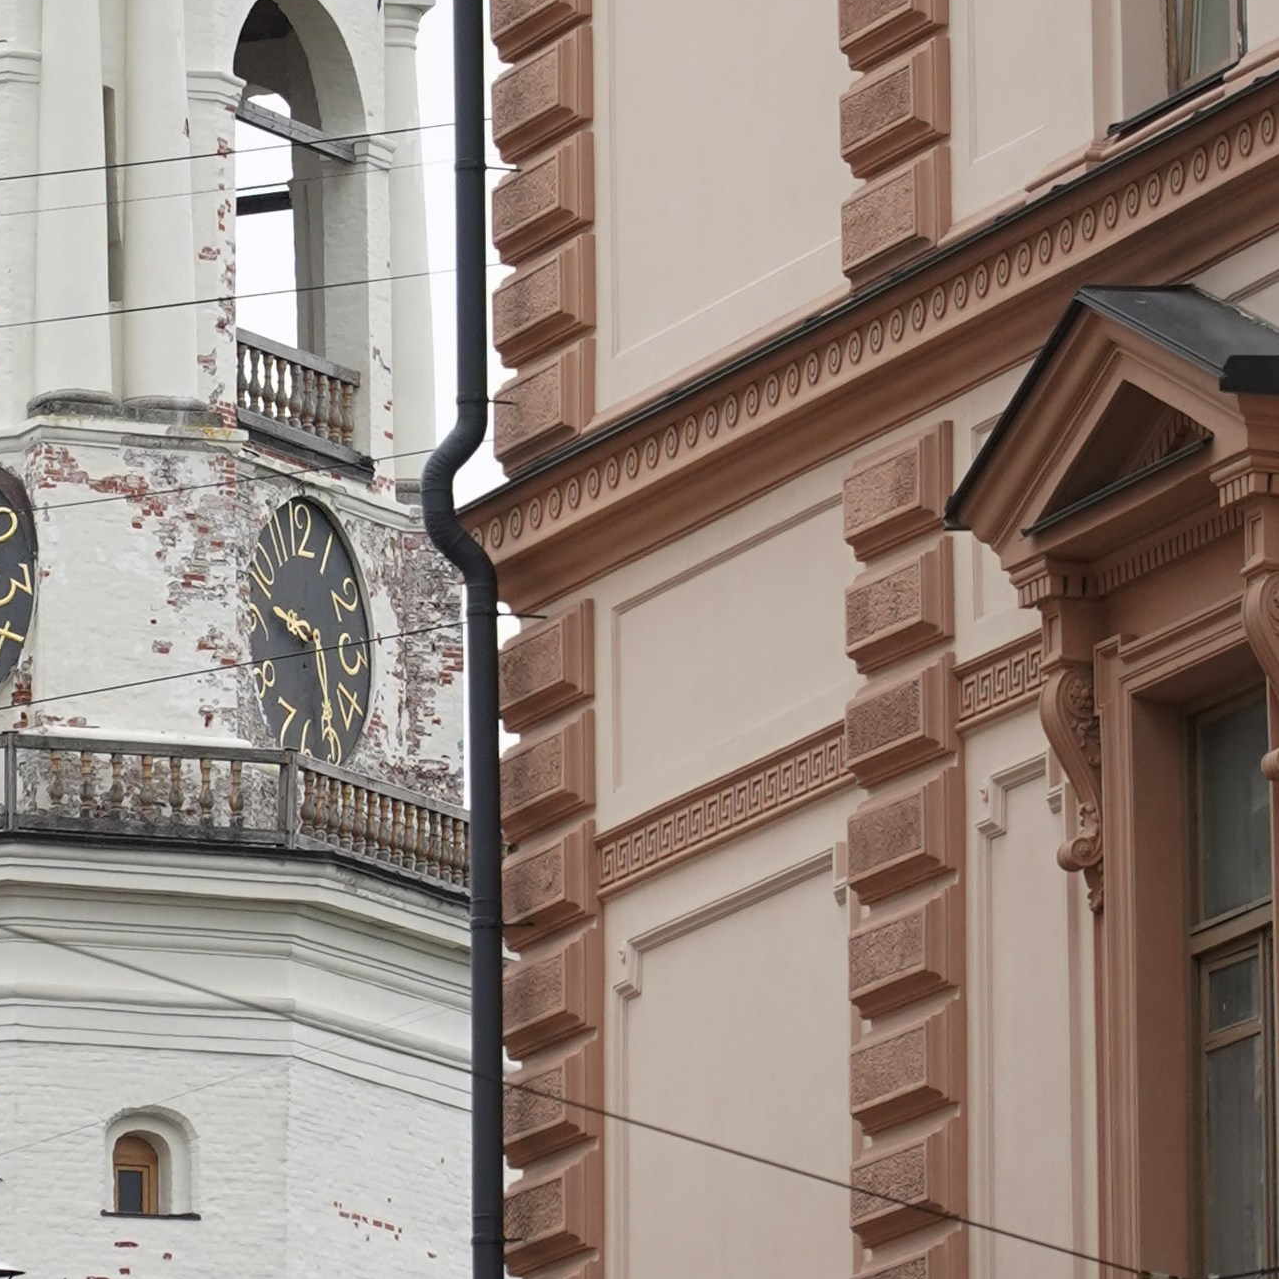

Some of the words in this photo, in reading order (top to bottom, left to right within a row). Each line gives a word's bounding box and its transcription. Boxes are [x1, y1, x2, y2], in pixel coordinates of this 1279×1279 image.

[268, 510, 289, 567] 11
[288, 501, 315, 559] 12
[320, 532, 334, 575] 1
[250, 542, 275, 600] 10
[331, 577, 358, 623] 2
[338, 632, 369, 676] 3
[278, 697, 297, 749] 7
[336, 682, 364, 732] 4
